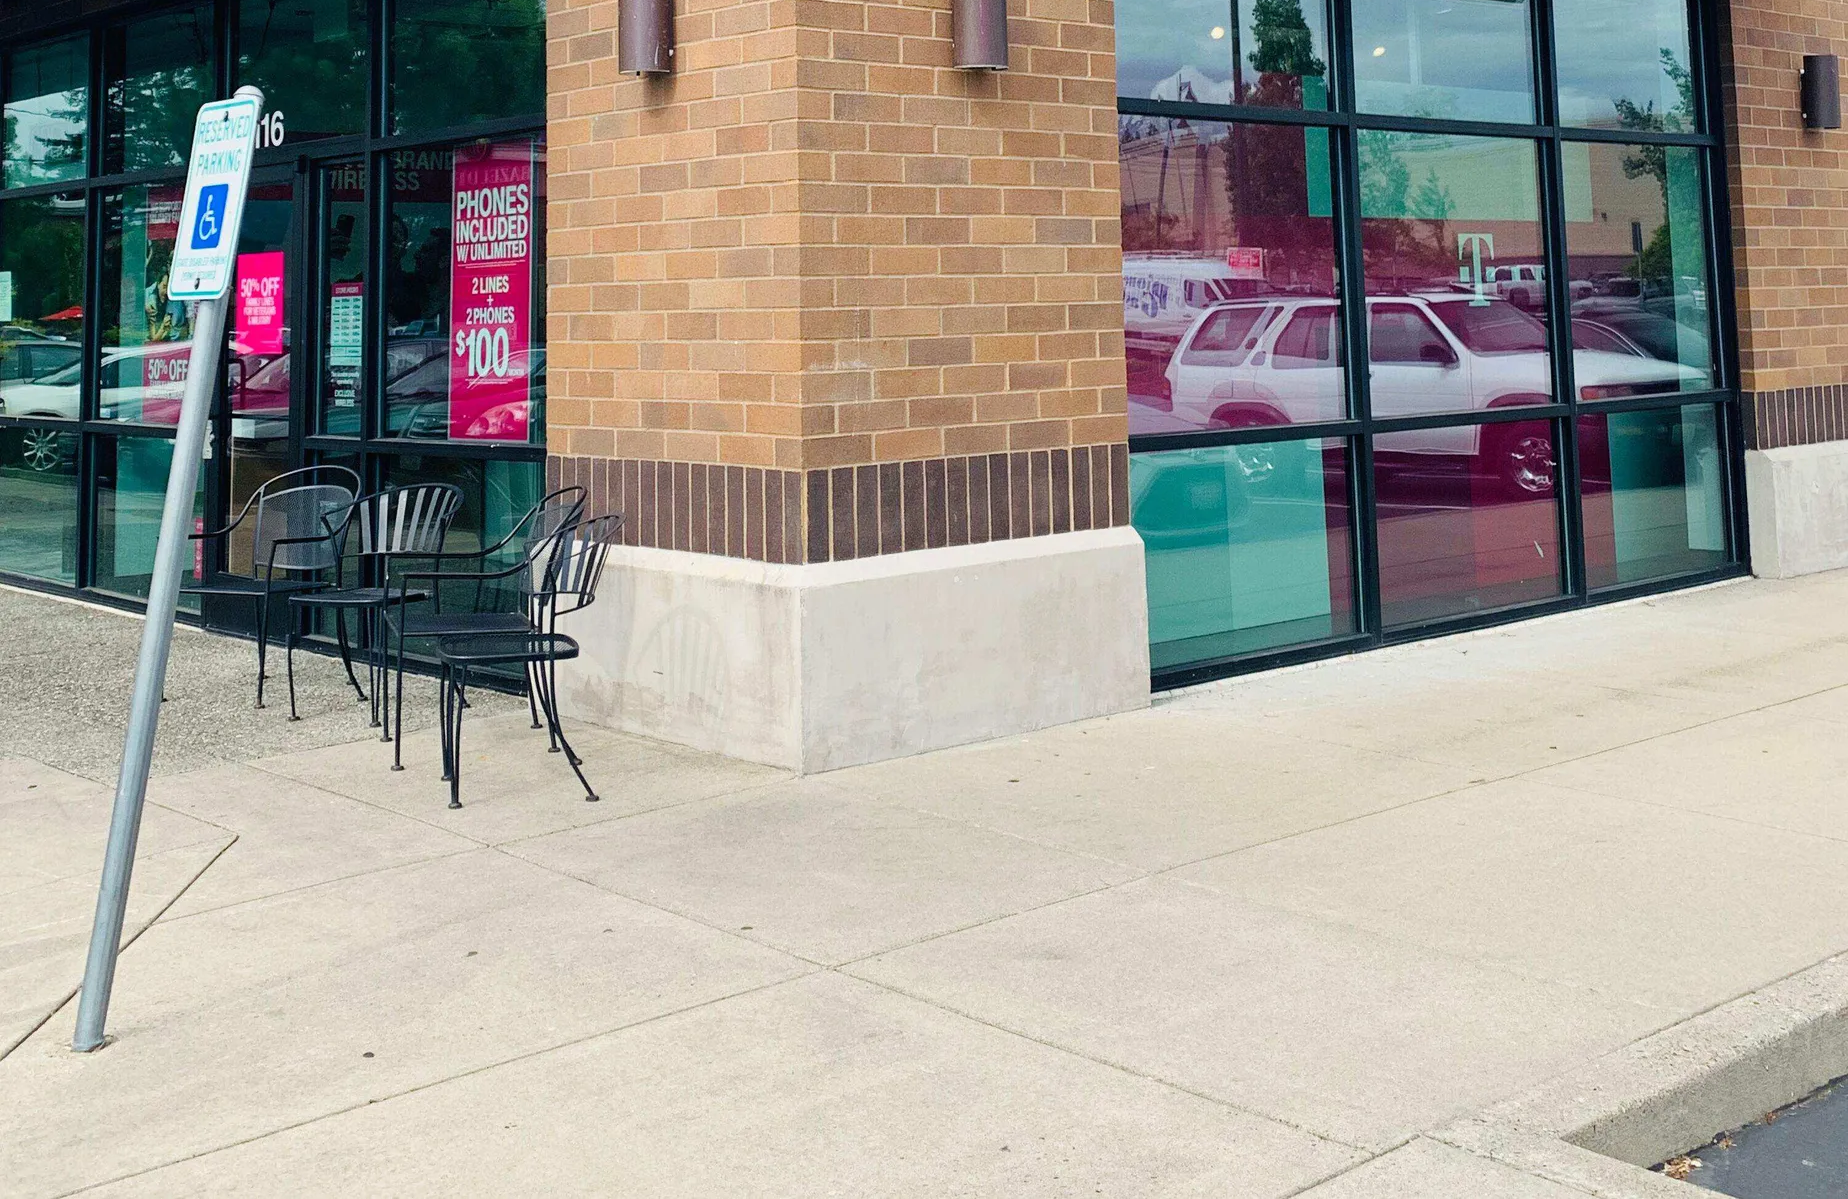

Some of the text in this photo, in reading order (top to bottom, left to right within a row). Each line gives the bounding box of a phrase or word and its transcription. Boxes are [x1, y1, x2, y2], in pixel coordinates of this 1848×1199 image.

[197, 115, 251, 145] RESERVED
[196, 149, 242, 177] PARKING
[456, 183, 529, 220] PHONES
[456, 214, 529, 244] INCLUDED
[456, 240, 527, 263] W/ UNLIMITED
[240, 276, 280, 298] 50% OFF
[472, 276, 509, 294] 2 LINES
[486, 295, 494, 306] +
[466, 306, 515, 325] 2 PHONES
[455, 327, 510, 378] $100
[148, 358, 188, 381] 50% OFF
